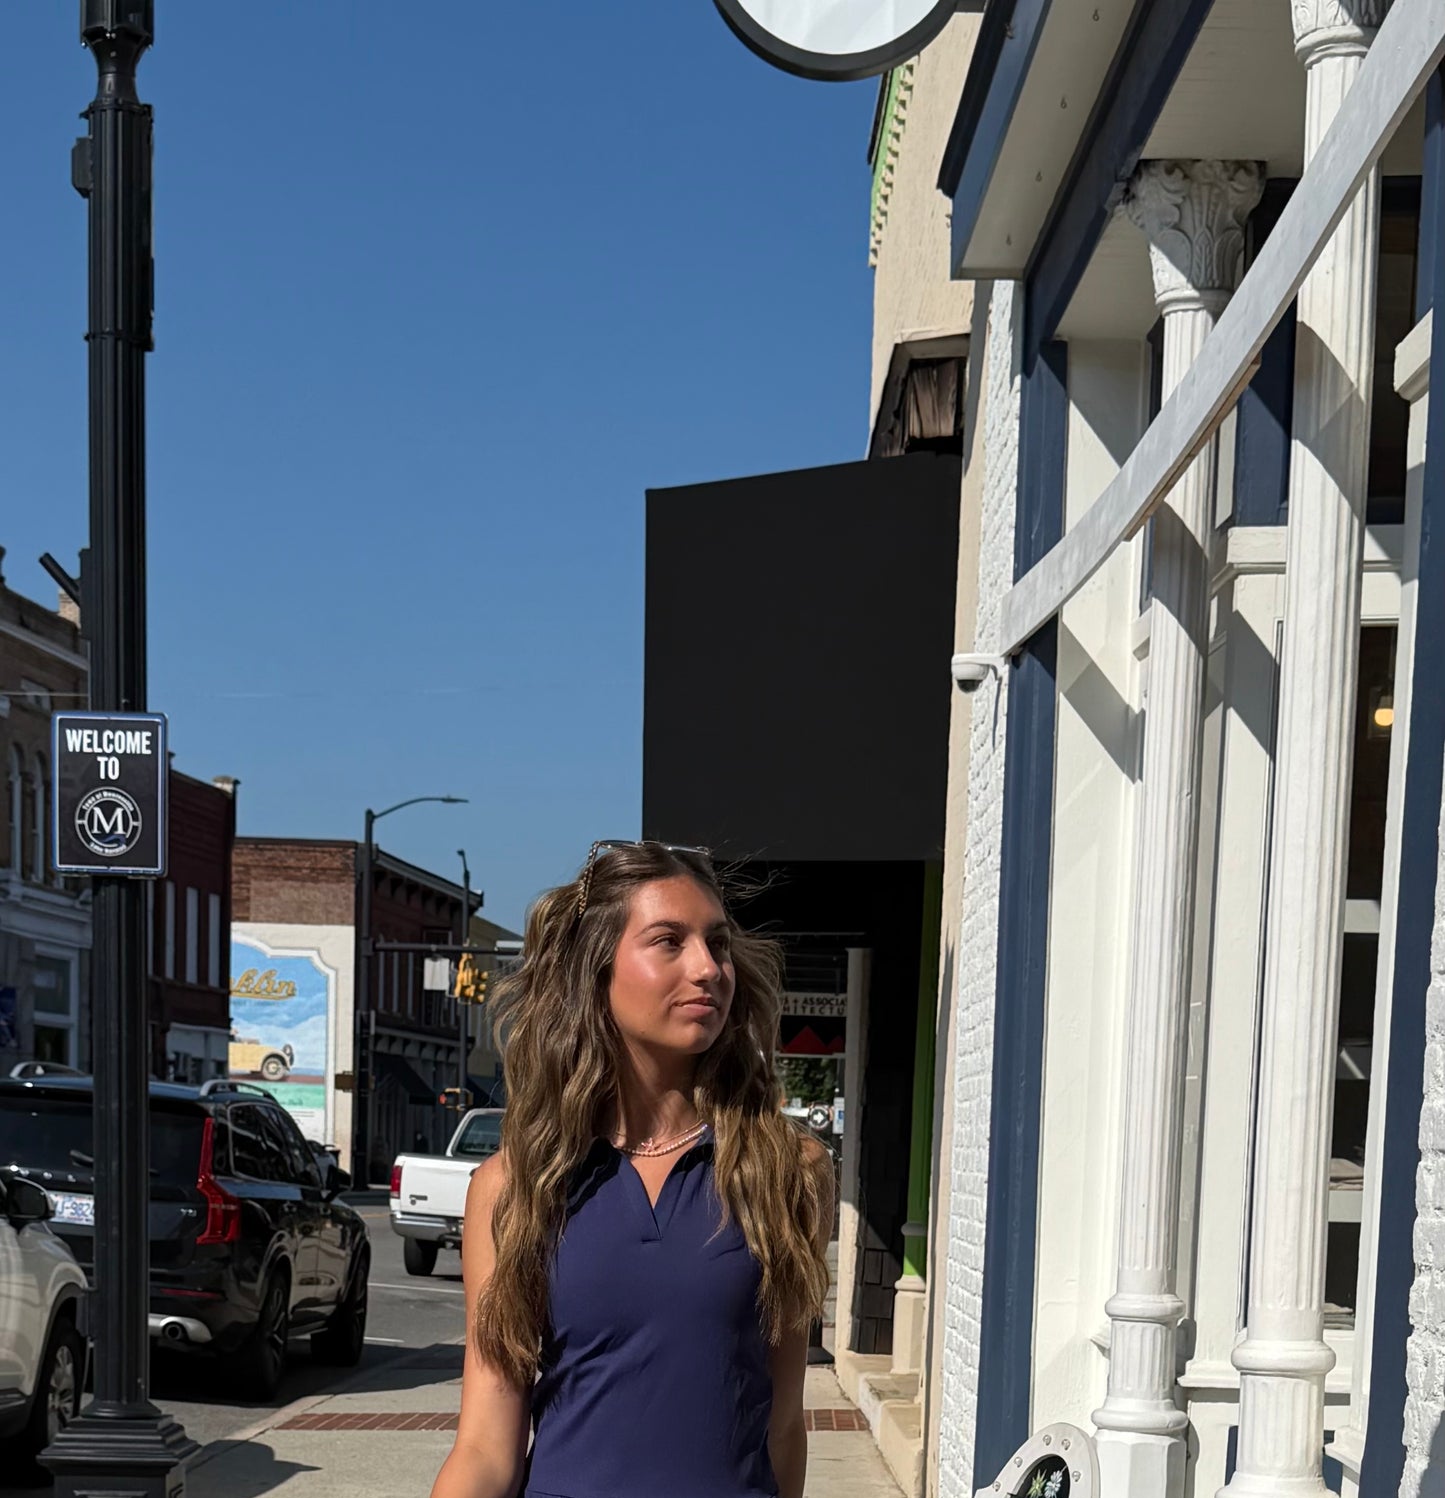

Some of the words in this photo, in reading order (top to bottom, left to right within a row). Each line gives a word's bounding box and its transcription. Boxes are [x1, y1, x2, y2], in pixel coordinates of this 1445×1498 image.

[65, 728, 152, 755] WELCOME
[97, 756, 120, 780] TO
[91, 806, 126, 835] M
[782, 1005, 845, 1015] HITECTU
[802, 996, 847, 1006] ASSOCIA
